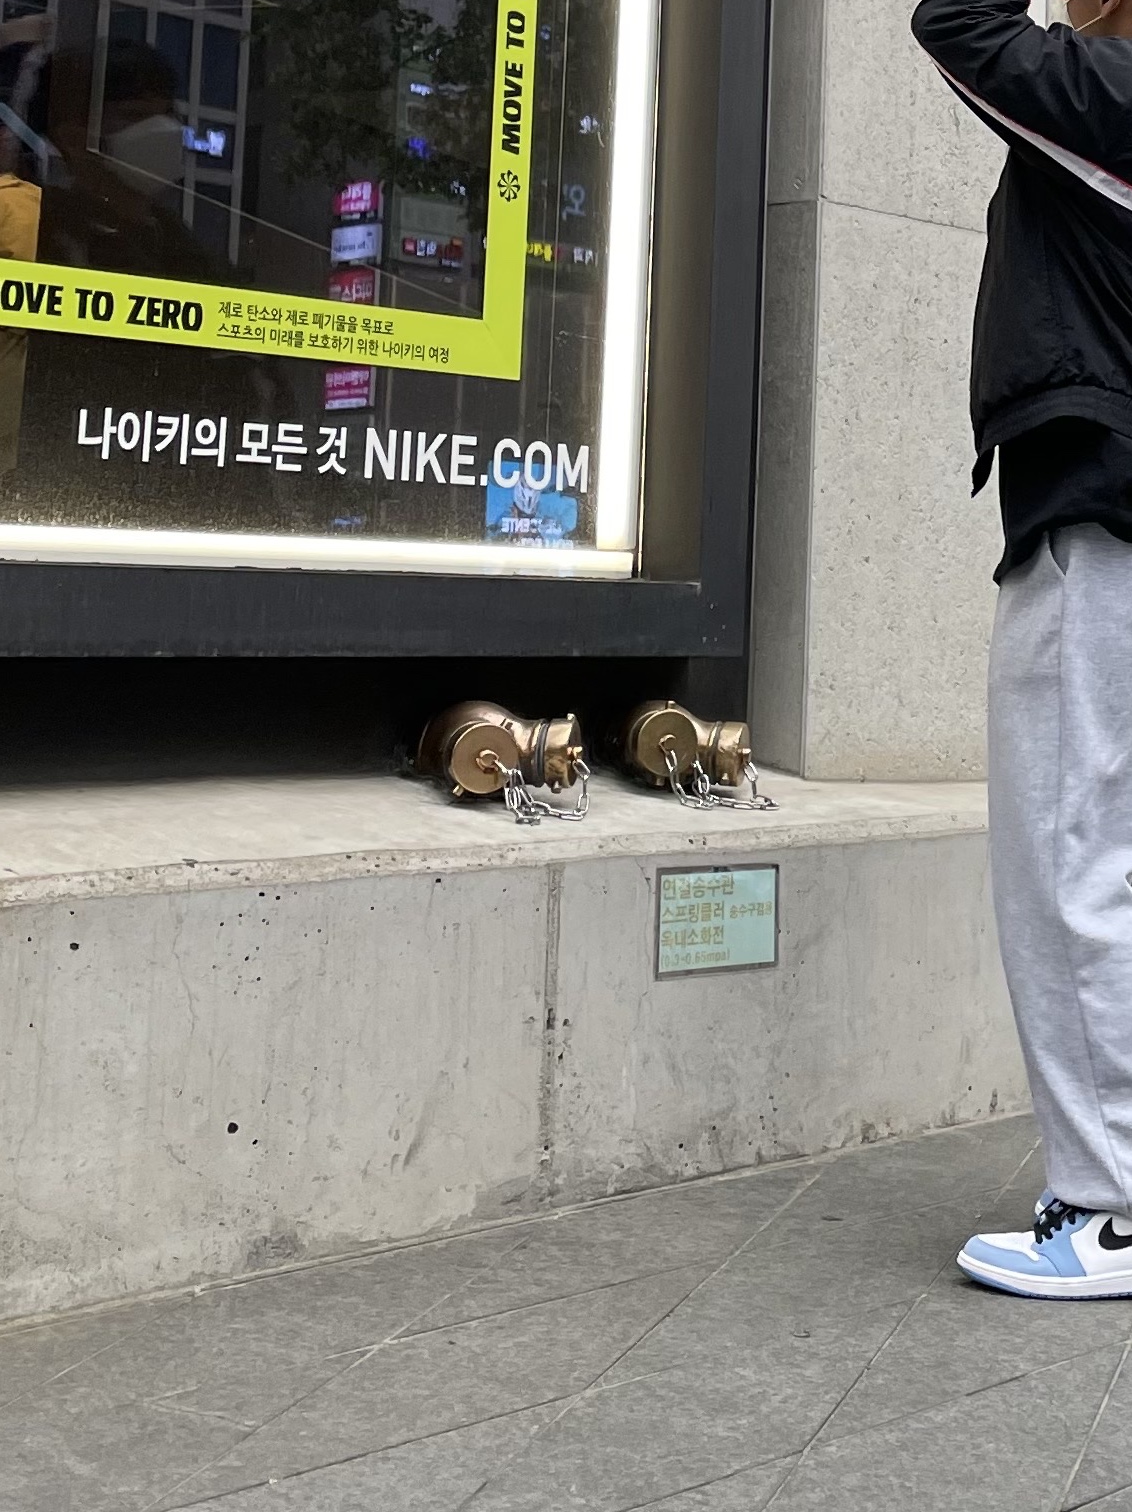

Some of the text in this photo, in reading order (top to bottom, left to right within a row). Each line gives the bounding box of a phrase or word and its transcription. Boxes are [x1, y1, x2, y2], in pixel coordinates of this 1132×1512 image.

[506, 10, 526, 50] TO
[501, 60, 524, 155] MOVE
[0, 279, 203, 332] OVE TO ZERO
[218, 301, 394, 335] 제로 탄소와 제로 폐기물을 목표로
[217, 323, 450, 364] 스포츠의 미래를 보호하기 위한 나이키의 여정
[77, 407, 590, 493] 나이키의 모든 것 NIKE.COM
[661, 901, 725, 924] 스프링클러
[661, 925, 724, 949] 옥내소화전
